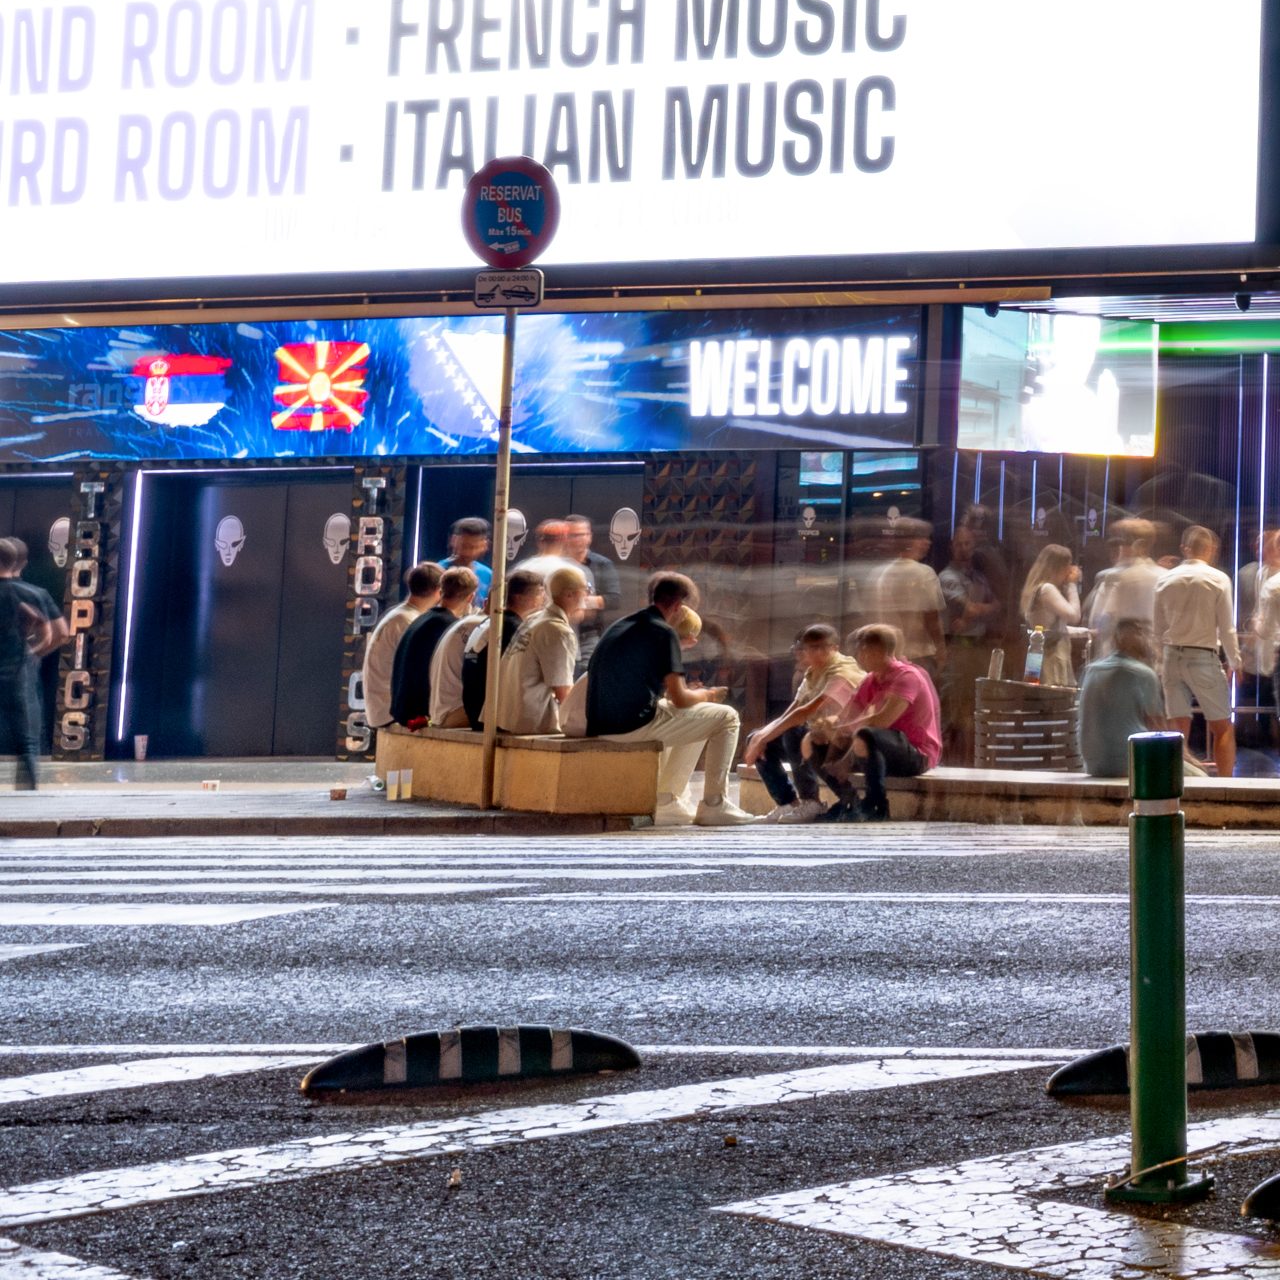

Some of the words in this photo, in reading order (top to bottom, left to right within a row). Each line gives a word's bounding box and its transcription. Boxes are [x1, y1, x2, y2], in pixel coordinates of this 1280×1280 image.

[0, 4, 96, 96] ND
[0, 115, 89, 207] RD
[113, 104, 311, 204] ROOM
[380, 87, 636, 194] ITALIAN
[660, 75, 897, 183] MUSIC
[480, 186, 542, 201] RESERVAT
[497, 207, 523, 223] BUS
[689, 336, 912, 417] WELCOME
[62, 481, 105, 751] TROPICS
[345, 476, 387, 752] TROPCS
